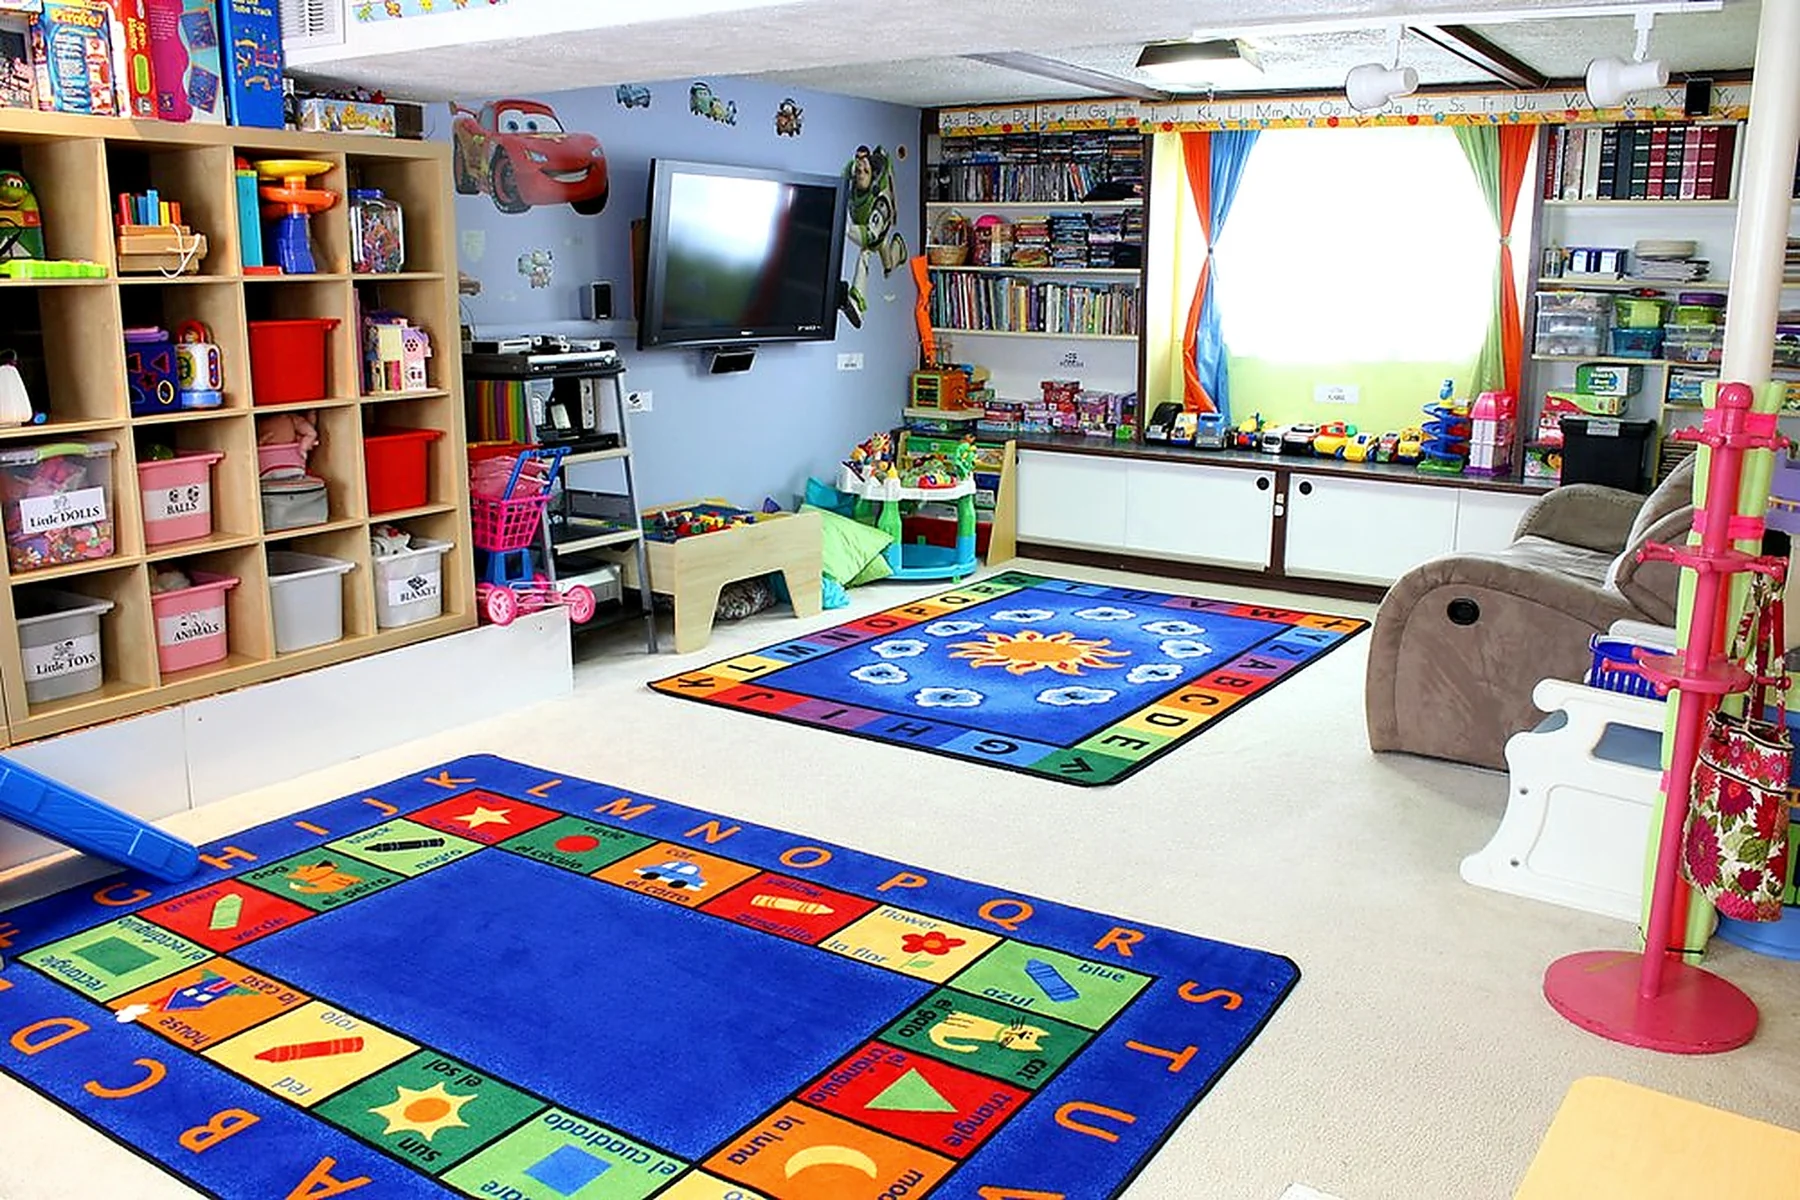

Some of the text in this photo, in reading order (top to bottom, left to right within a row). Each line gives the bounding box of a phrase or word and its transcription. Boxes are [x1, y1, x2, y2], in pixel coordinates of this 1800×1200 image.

[1256, 104, 1283, 118] Mm
[1290, 103, 1311, 116] Nn
[1319, 101, 1341, 115] Oo
[1417, 98, 1434, 112] Rr
[1449, 97, 1466, 112] Ss
[1513, 95, 1536, 110] Uu
[1564, 93, 1584, 108] Vv
[1715, 88, 1736, 106] Yy
[30, 506, 100, 528] Little DOLLS
[166, 501, 198, 515] BALLS
[173, 623, 220, 642] ANIMALS
[678, 677, 715, 688] K
[727, 664, 767, 674] L
[865, 618, 898, 628] O
[940, 596, 975, 605] Q
[36, 653, 97, 675] Little TOYS
[737, 692, 775, 702] J
[1101, 632, 1329, 750] Y Z A B C D E
[886, 722, 933, 737] H
[974, 739, 1020, 755] G
[93, 771, 476, 906] G H I J K
[414, 849, 463, 870] negro
[664, 847, 697, 861] car
[251, 865, 289, 881] dog
[526, 779, 1145, 957] L M N O P Q R
[624, 876, 691, 903] el carro
[764, 876, 821, 898] yellow
[735, 911, 813, 943] amarillo
[879, 908, 941, 931] flower
[183, 946, 208, 961] el
[828, 939, 888, 965] la flor
[40, 954, 107, 991] rectangle
[1077, 960, 1126, 984] blue
[241, 975, 301, 1007] la casa
[981, 986, 1036, 1009] azul
[320, 1010, 358, 1031] rojo
[898, 998, 954, 1038] el gato
[158, 1016, 211, 1048] house
[885, 1050, 906, 1068] el
[1016, 1057, 1048, 1083] cat
[1054, 980, 1243, 1143] S T U
[423, 1057, 482, 1089] el sol
[271, 1076, 313, 1097] red
[9, 1017, 373, 1200] D C B A
[941, 1091, 1014, 1149] triangle
[397, 1135, 442, 1164] sun
[543, 1113, 679, 1178] el cuadrado
[727, 1113, 806, 1166] la luna
[877, 1168, 925, 1200] moo
